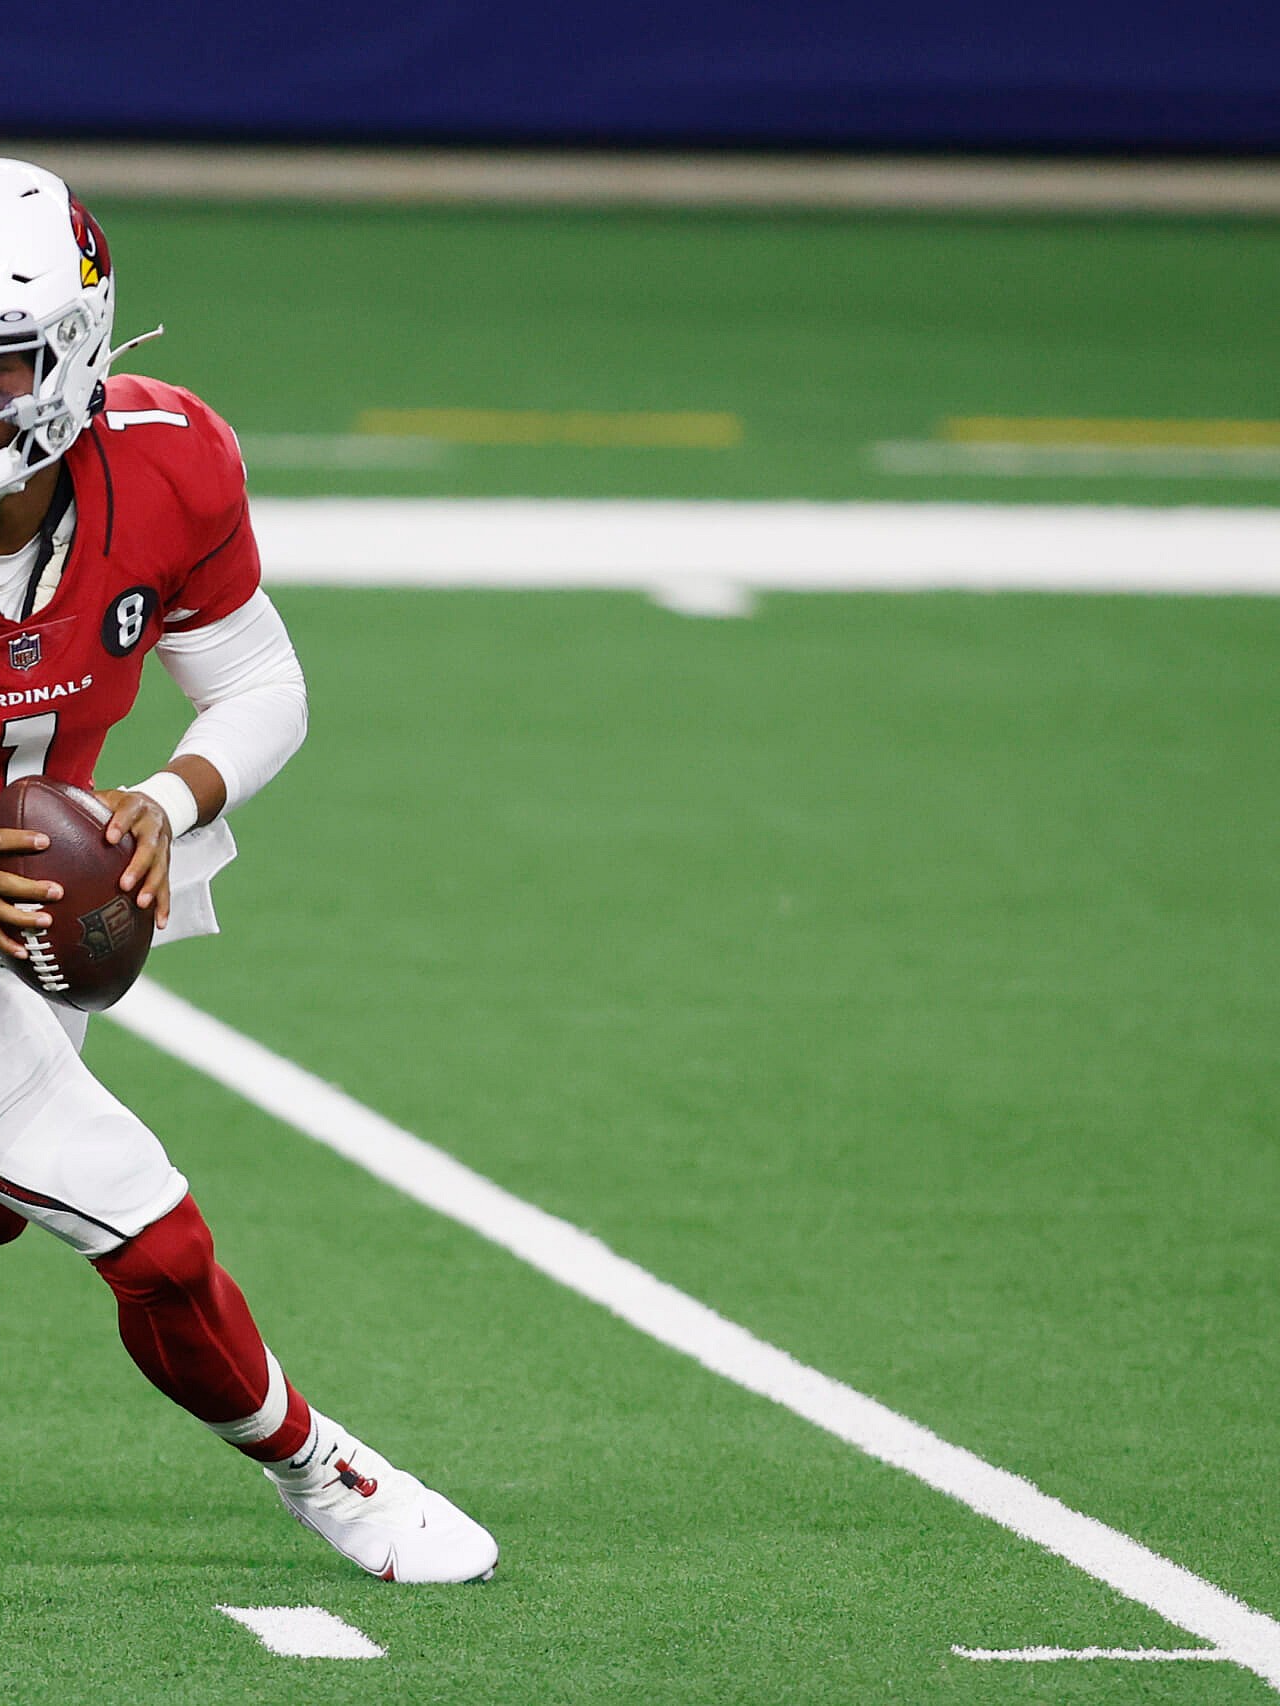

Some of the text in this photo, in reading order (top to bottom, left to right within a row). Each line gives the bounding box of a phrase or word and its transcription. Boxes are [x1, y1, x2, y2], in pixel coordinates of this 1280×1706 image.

[105, 409, 190, 431] 1
[116, 592, 145, 649] 8
[2, 709, 58, 787] 1
